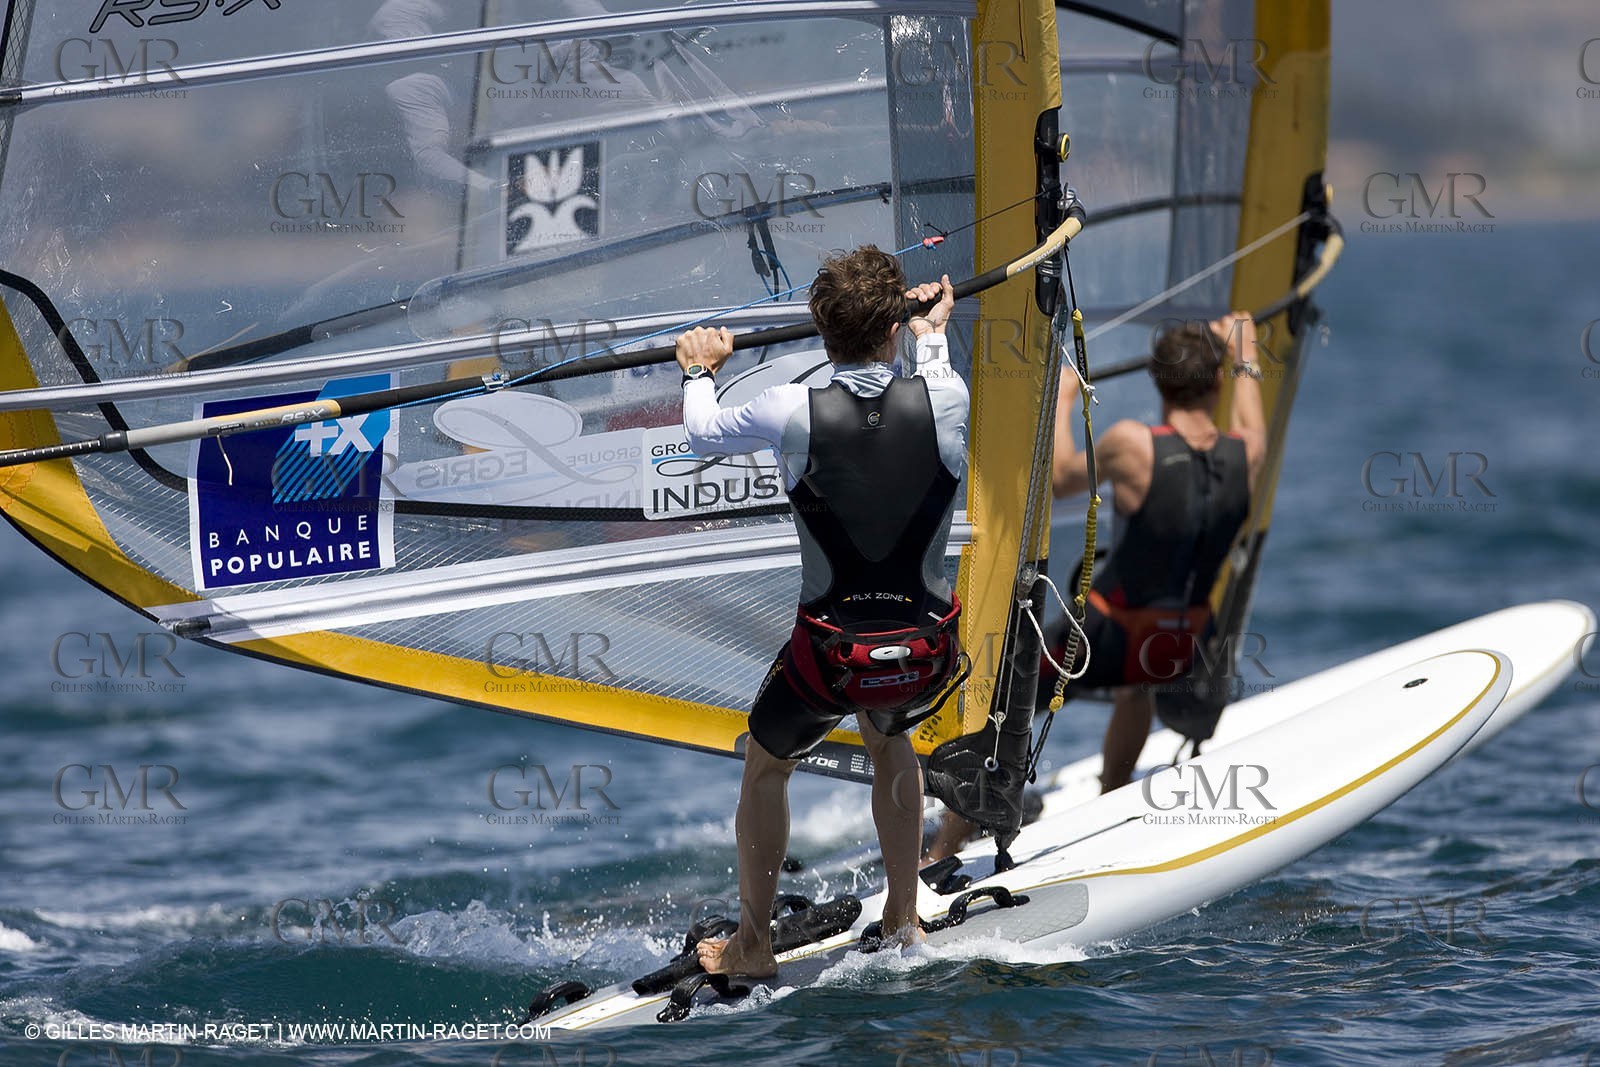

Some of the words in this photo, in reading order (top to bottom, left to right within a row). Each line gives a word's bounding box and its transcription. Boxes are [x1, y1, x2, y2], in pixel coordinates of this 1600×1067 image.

[652, 473, 782, 514] INDUS
[208, 513, 368, 549] BANQUE
[210, 540, 372, 577] POPULAIRE
[875, 592, 905, 602] ZONE
